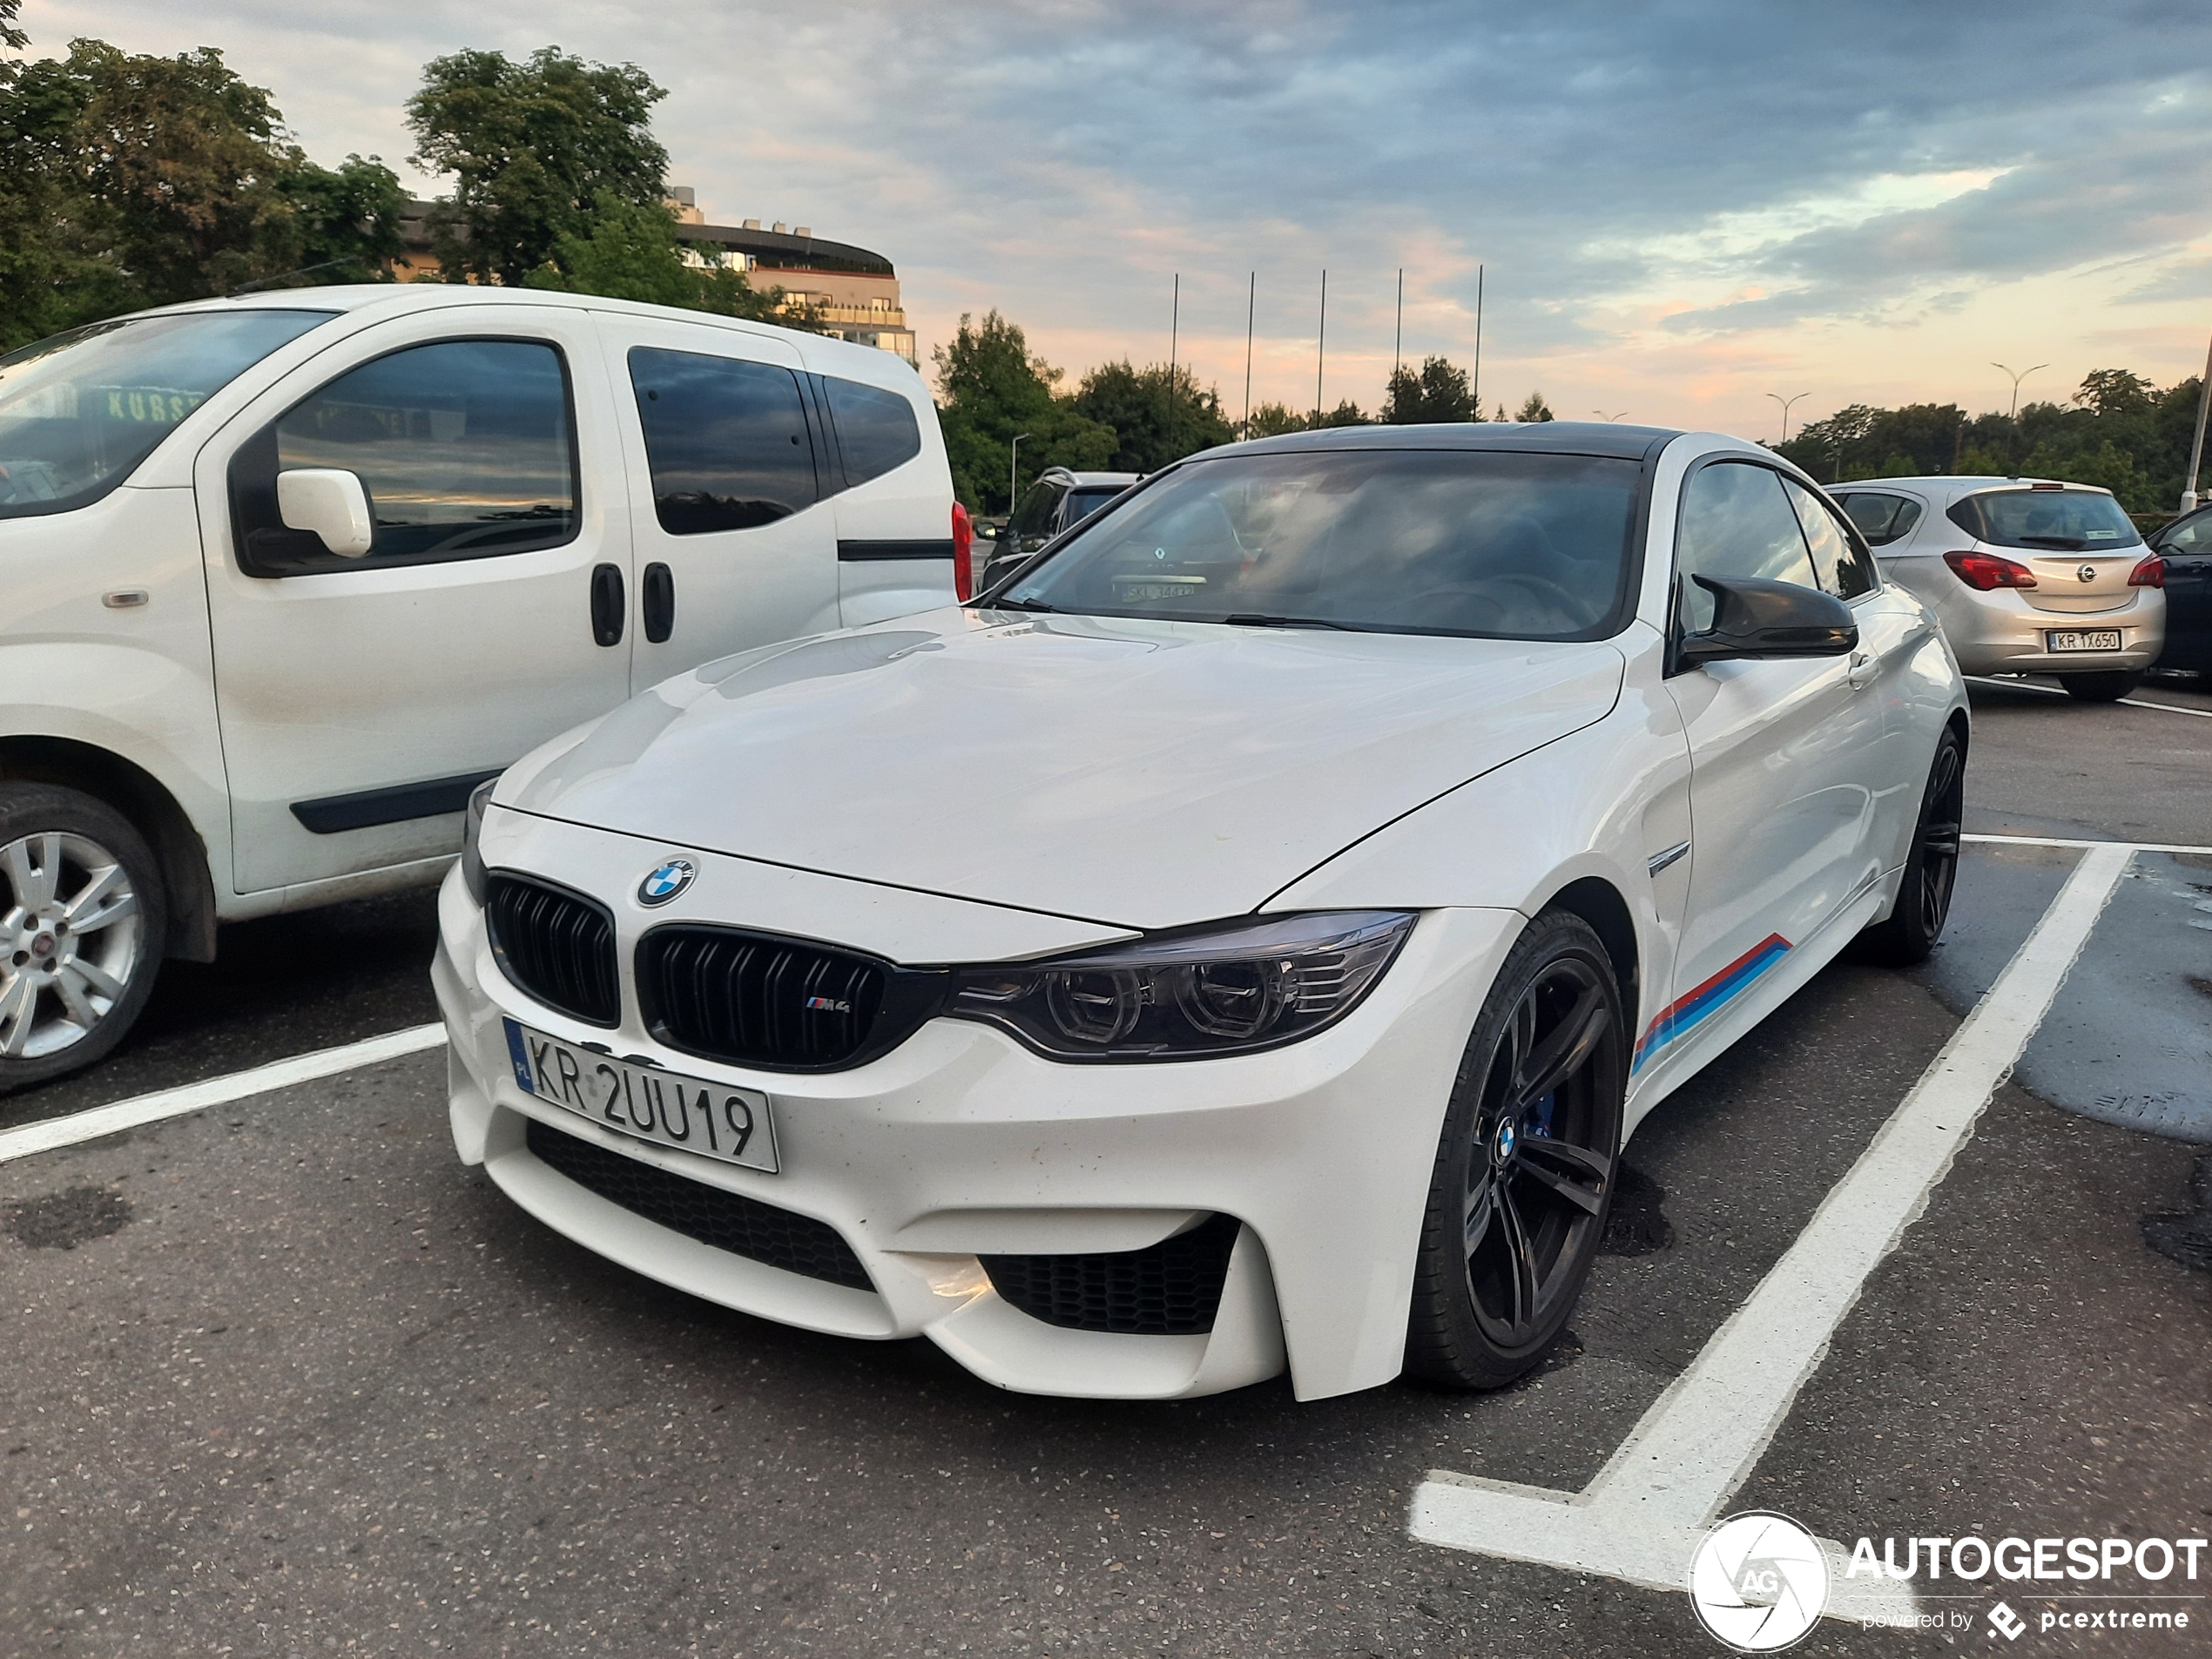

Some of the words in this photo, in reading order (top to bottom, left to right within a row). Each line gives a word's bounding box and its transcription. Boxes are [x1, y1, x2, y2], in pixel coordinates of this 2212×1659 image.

[2058, 634, 2076, 649] KR
[812, 997, 850, 1013] M4
[516, 1062, 530, 1080] PL
[529, 1035, 587, 1110] KR
[597, 1062, 754, 1157] 2UU19
